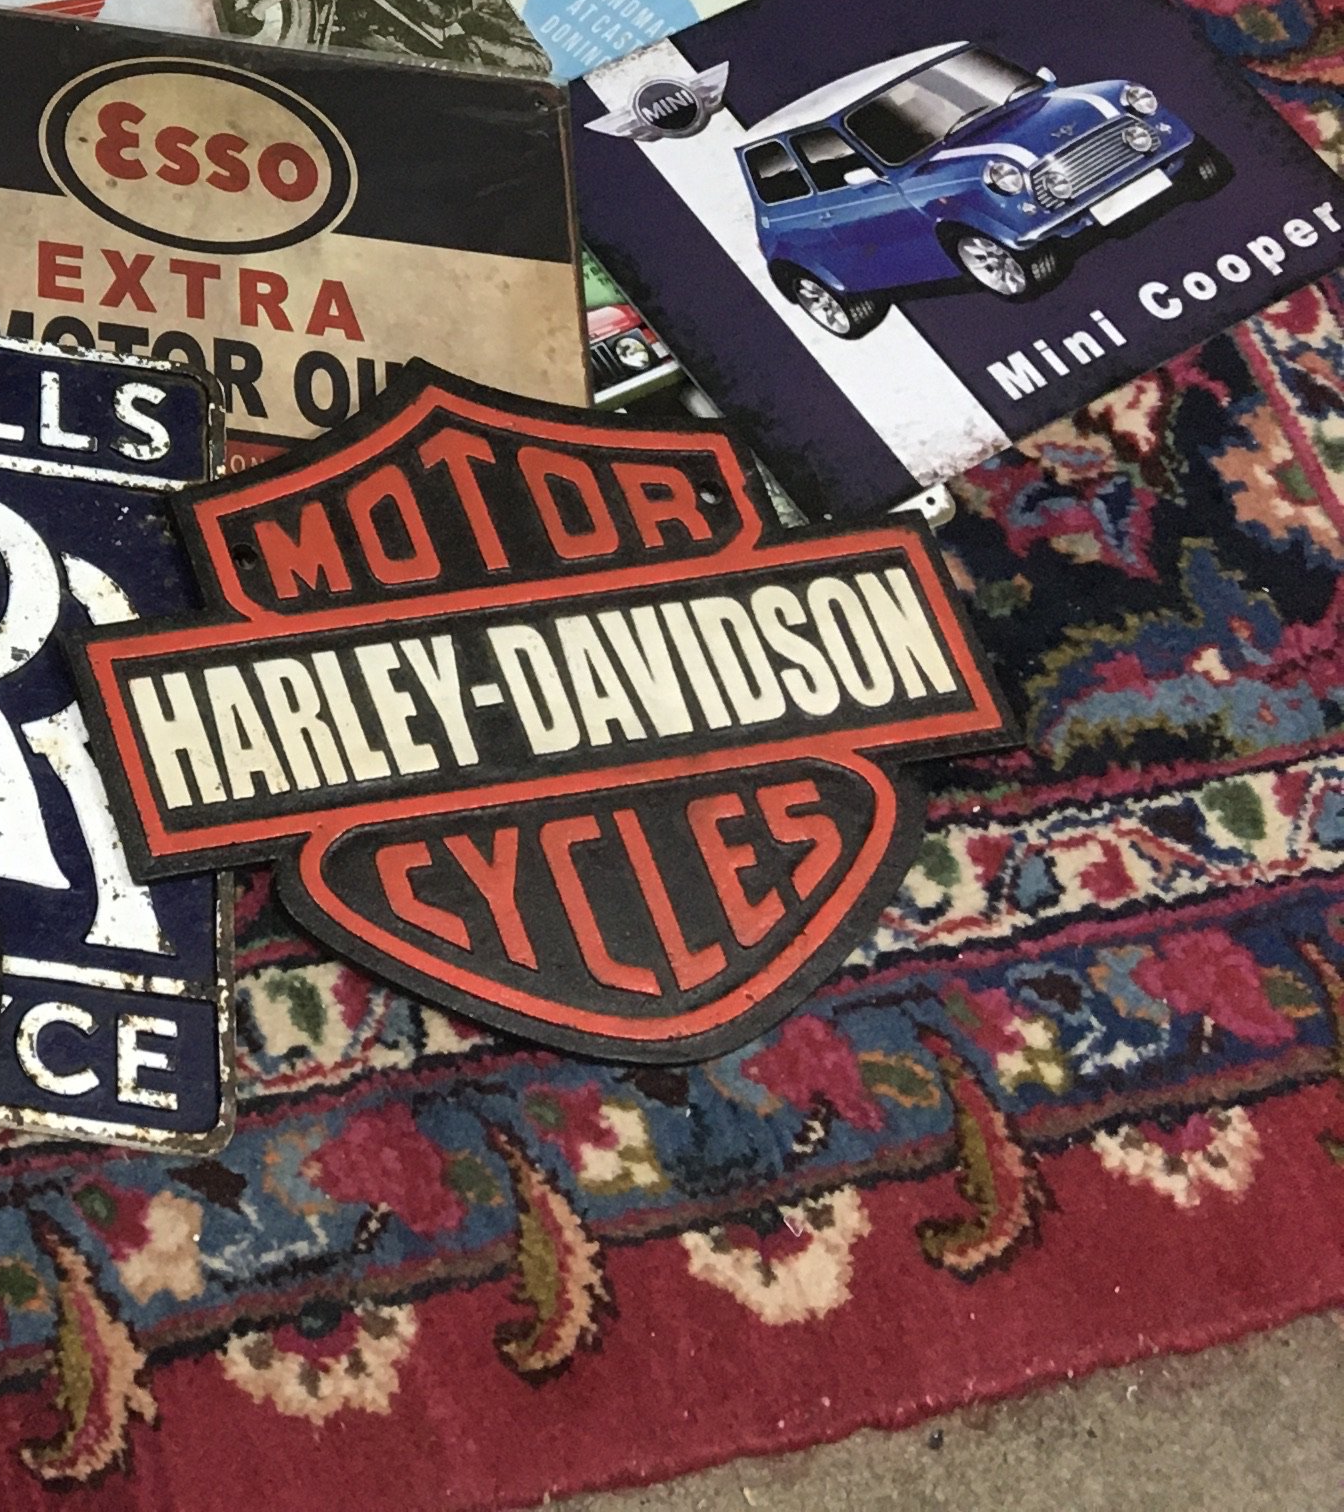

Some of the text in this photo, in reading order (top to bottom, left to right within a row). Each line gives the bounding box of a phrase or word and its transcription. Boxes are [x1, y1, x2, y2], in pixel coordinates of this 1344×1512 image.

[641, 89, 695, 123] MINI
[37, 240, 365, 343] EXTRA
[985, 196, 1344, 403] Mini Cooper
[252, 426, 714, 602] MOTOR
[129, 566, 959, 811] HARLEY-DAVIDSON
[374, 780, 842, 998] CYCLES
